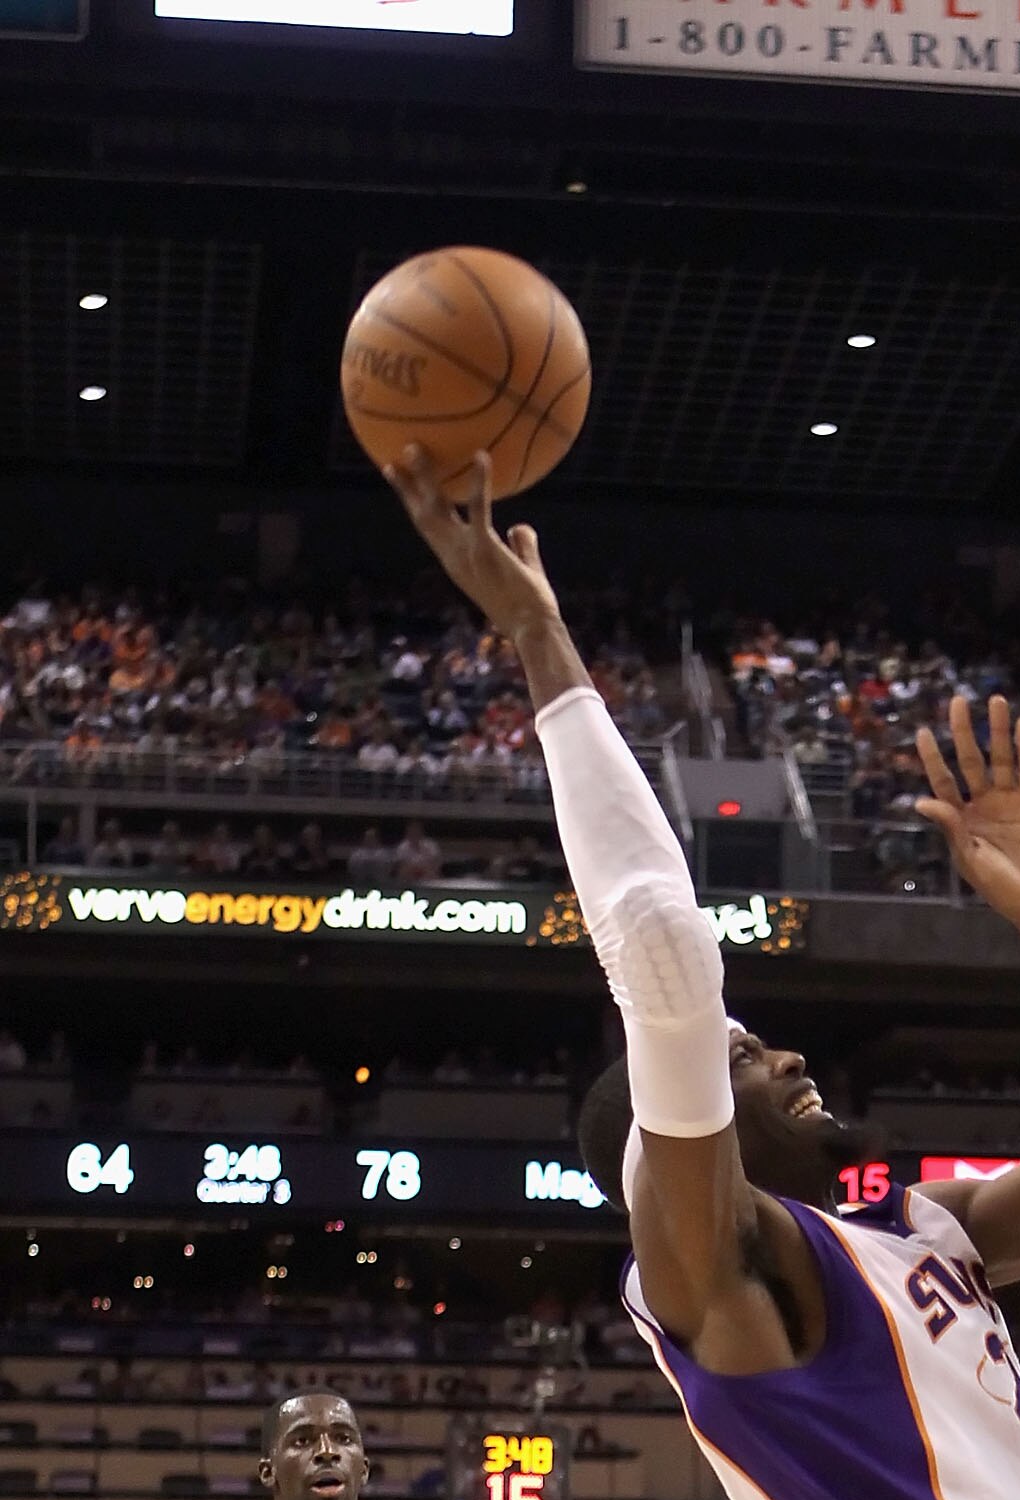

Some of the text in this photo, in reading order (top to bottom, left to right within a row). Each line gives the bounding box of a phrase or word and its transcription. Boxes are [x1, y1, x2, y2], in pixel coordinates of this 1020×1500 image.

[68, 887, 527, 934] verveenergydrink.com
[67, 1142, 134, 1194] 64
[356, 1150, 421, 1200] 78
[525, 1160, 605, 1208] Mag
[838, 1162, 890, 1203] 15
